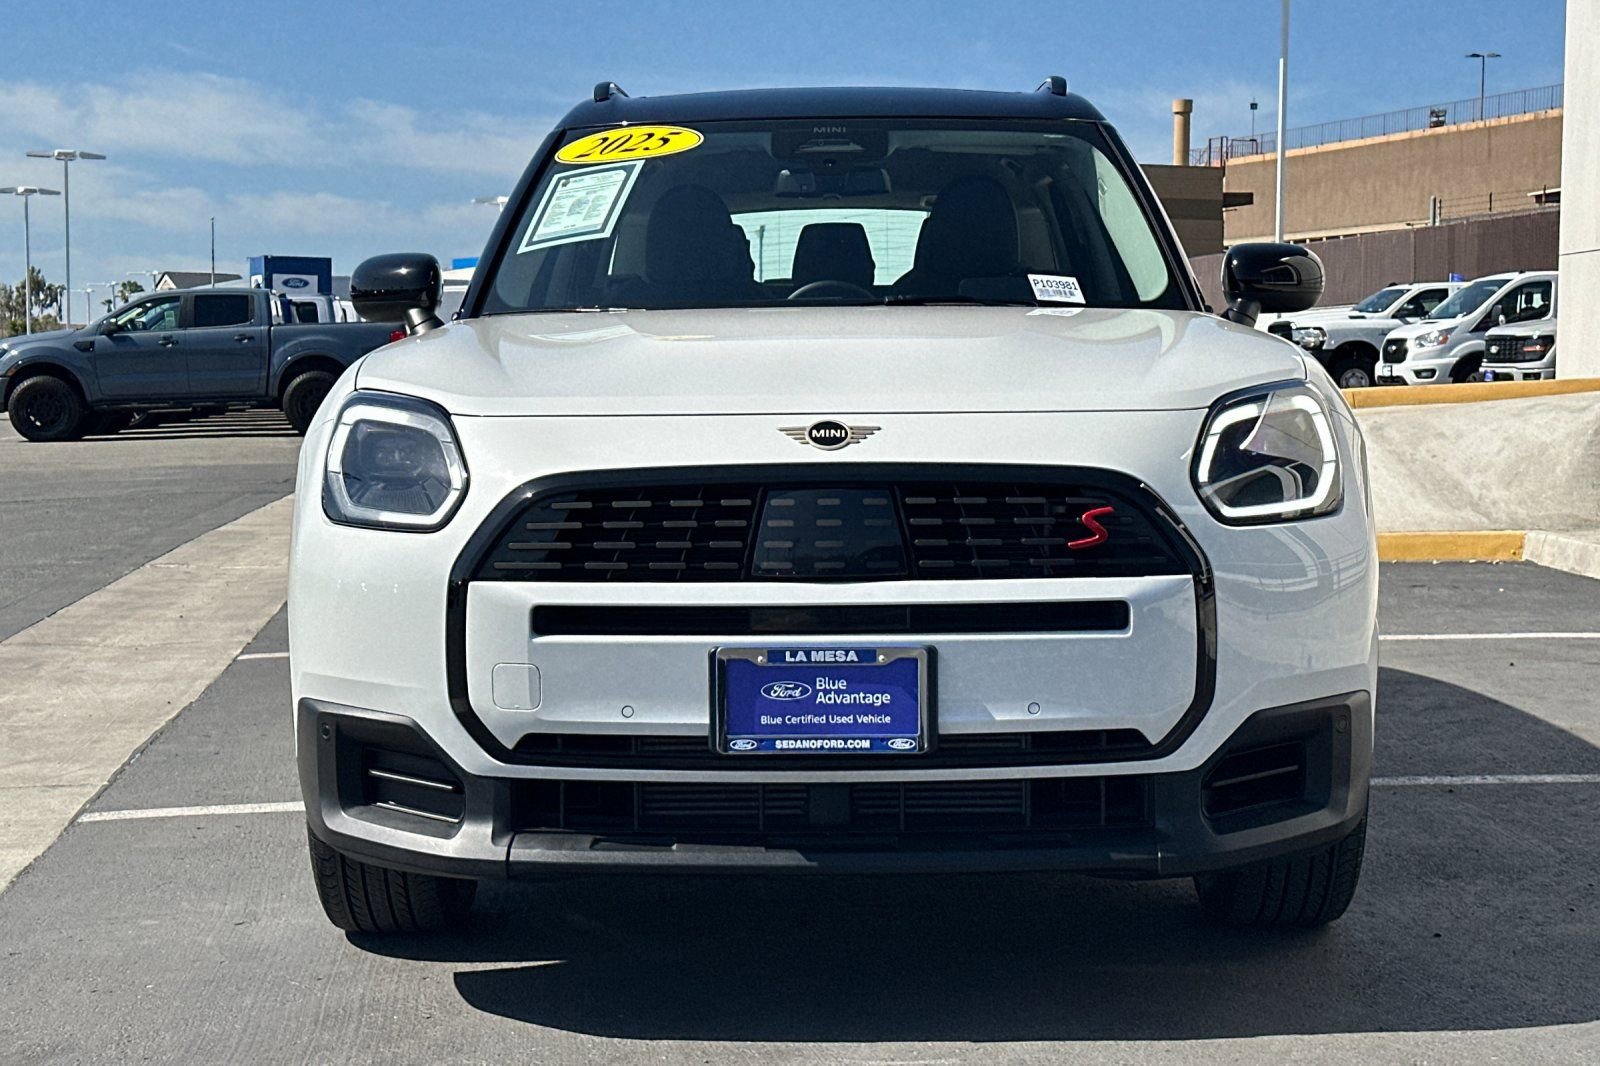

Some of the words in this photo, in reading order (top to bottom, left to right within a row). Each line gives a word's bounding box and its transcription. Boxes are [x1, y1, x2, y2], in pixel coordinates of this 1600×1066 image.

[574, 132, 683, 159] 2025
[1032, 278, 1079, 291] P103981
[811, 429, 846, 438] MINI
[1067, 506, 1114, 550] S
[785, 650, 808, 662] LA
[811, 650, 859, 662] MESA
[815, 677, 847, 690] Blue
[770, 683, 803, 698] Ford
[815, 691, 891, 706] Advantage
[760, 715, 783, 725] Blue
[785, 714, 826, 724] Certified
[829, 714, 854, 724] Used
[857, 714, 891, 724] Vehicle
[775, 739, 871, 749] SEDANOFORD.COM
